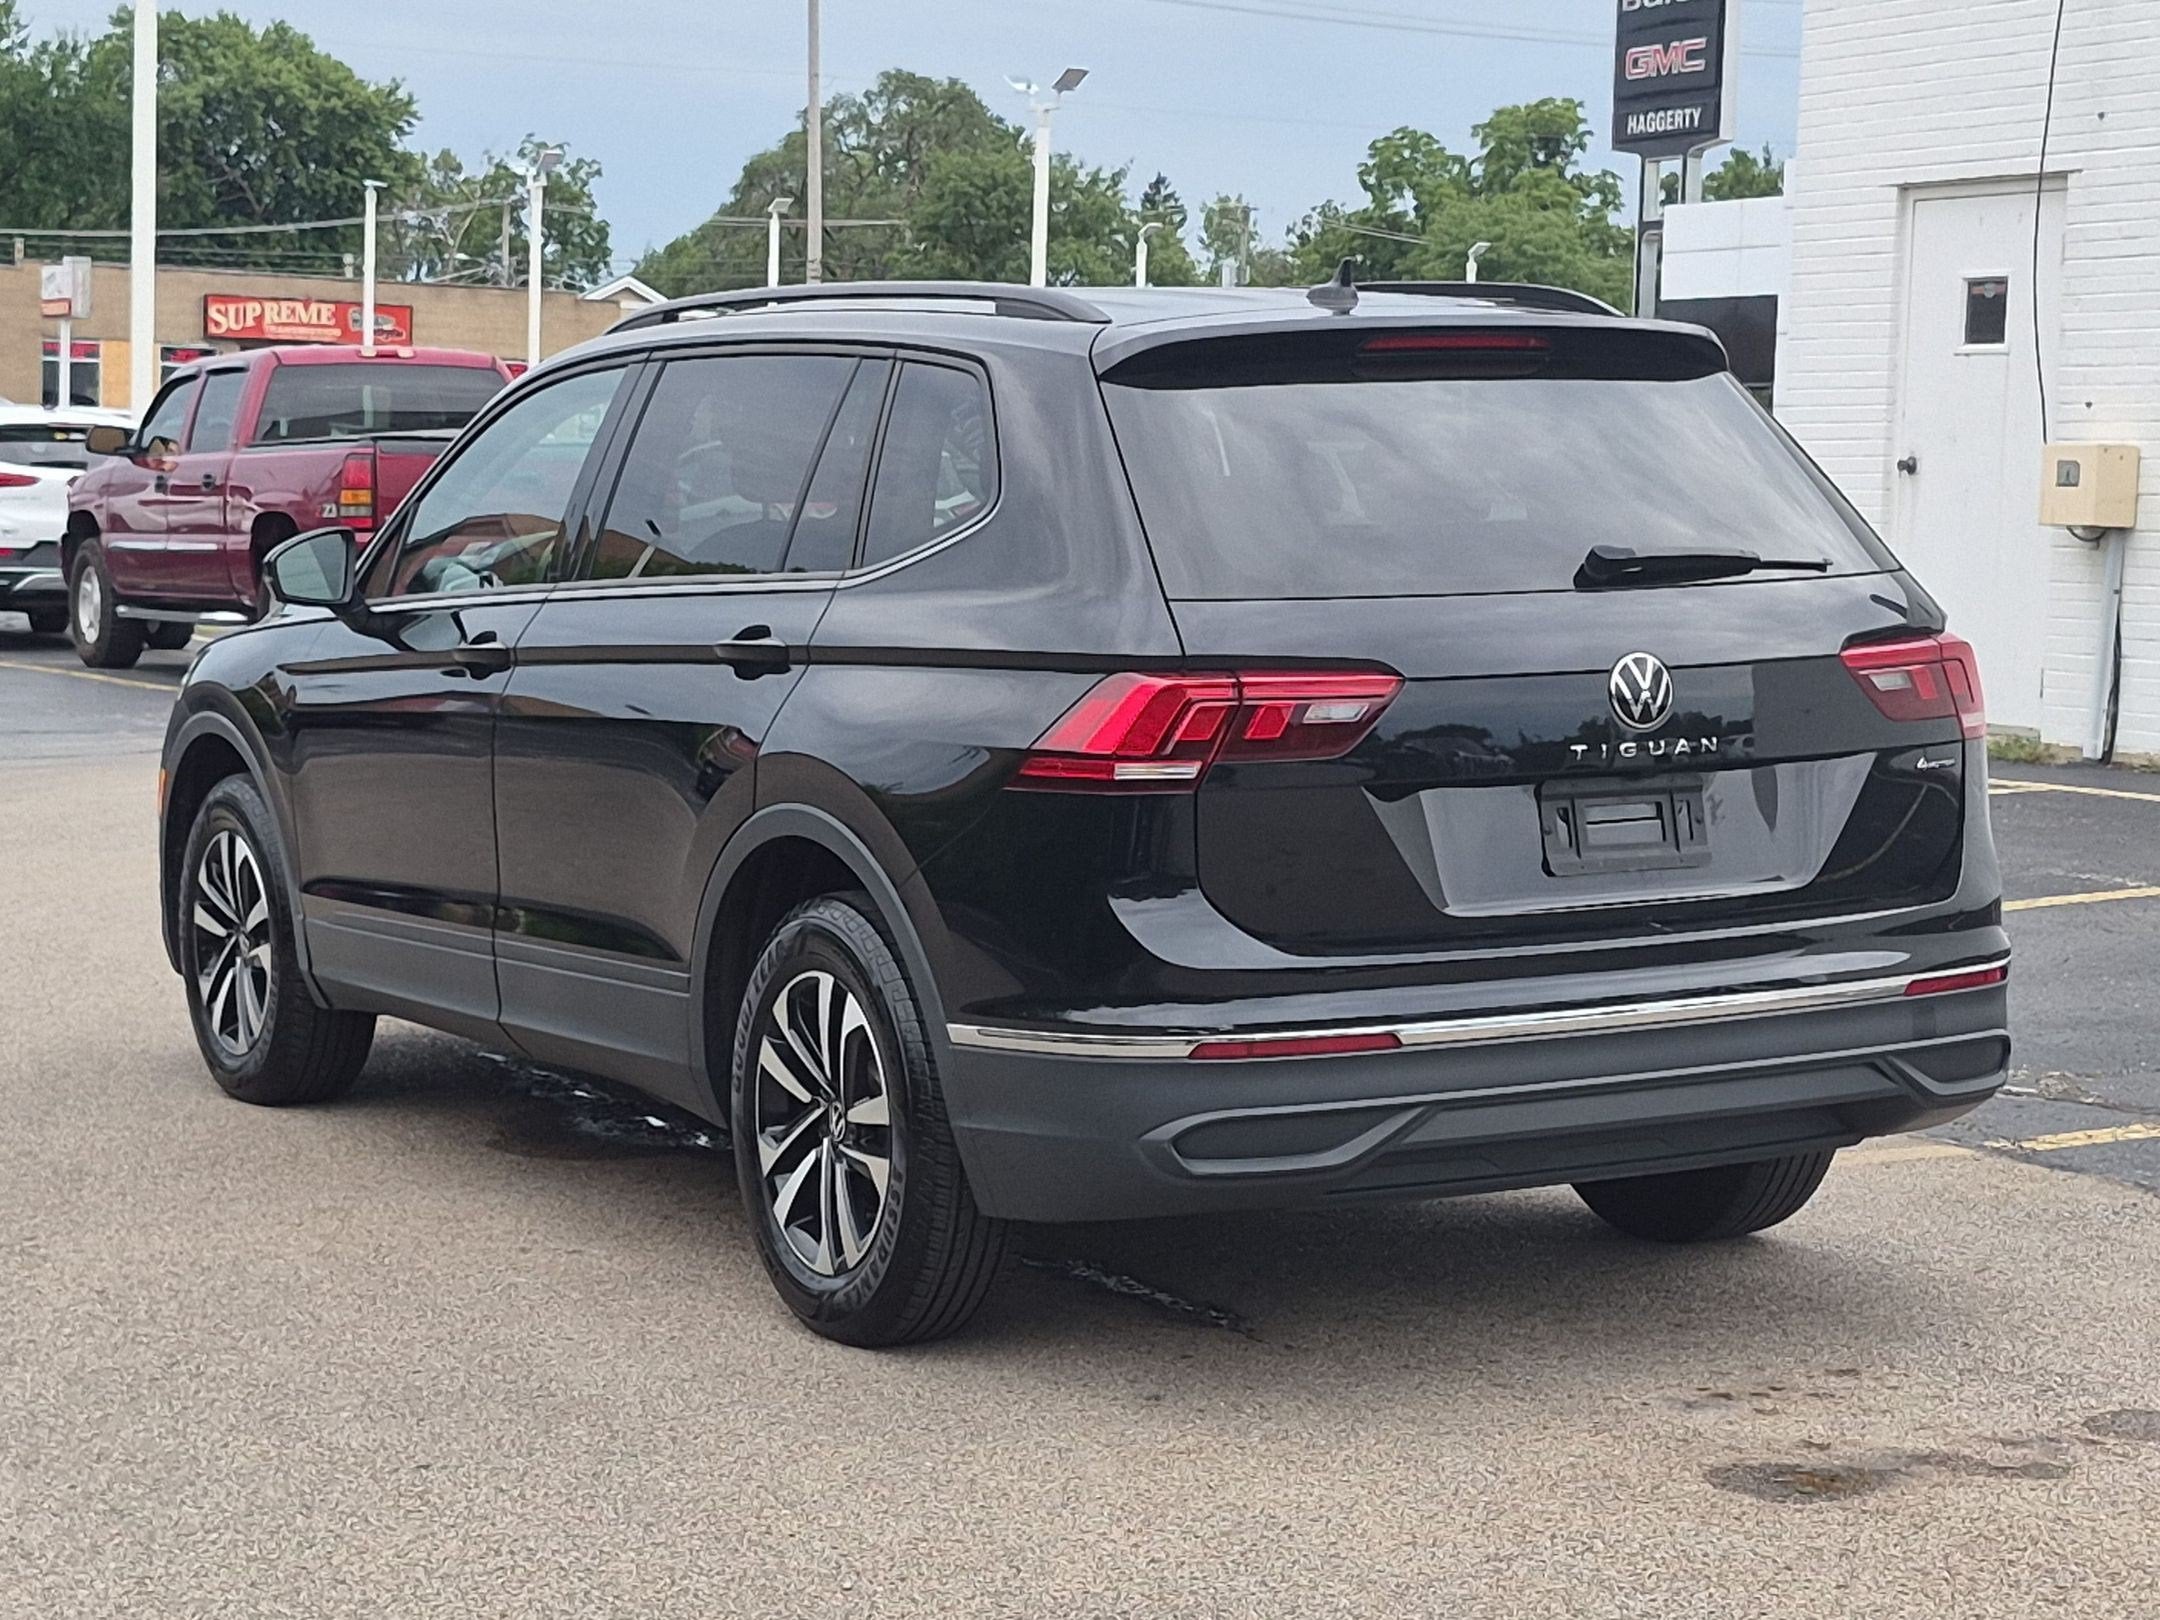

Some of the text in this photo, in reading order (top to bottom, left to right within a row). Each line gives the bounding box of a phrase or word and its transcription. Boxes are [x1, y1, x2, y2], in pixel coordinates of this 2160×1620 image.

[1625, 37, 1707, 80] GMC
[1627, 107, 1702, 135] HAGGERTY
[208, 301, 337, 334] SUPREME
[1570, 736, 1718, 760] TIGUAN
